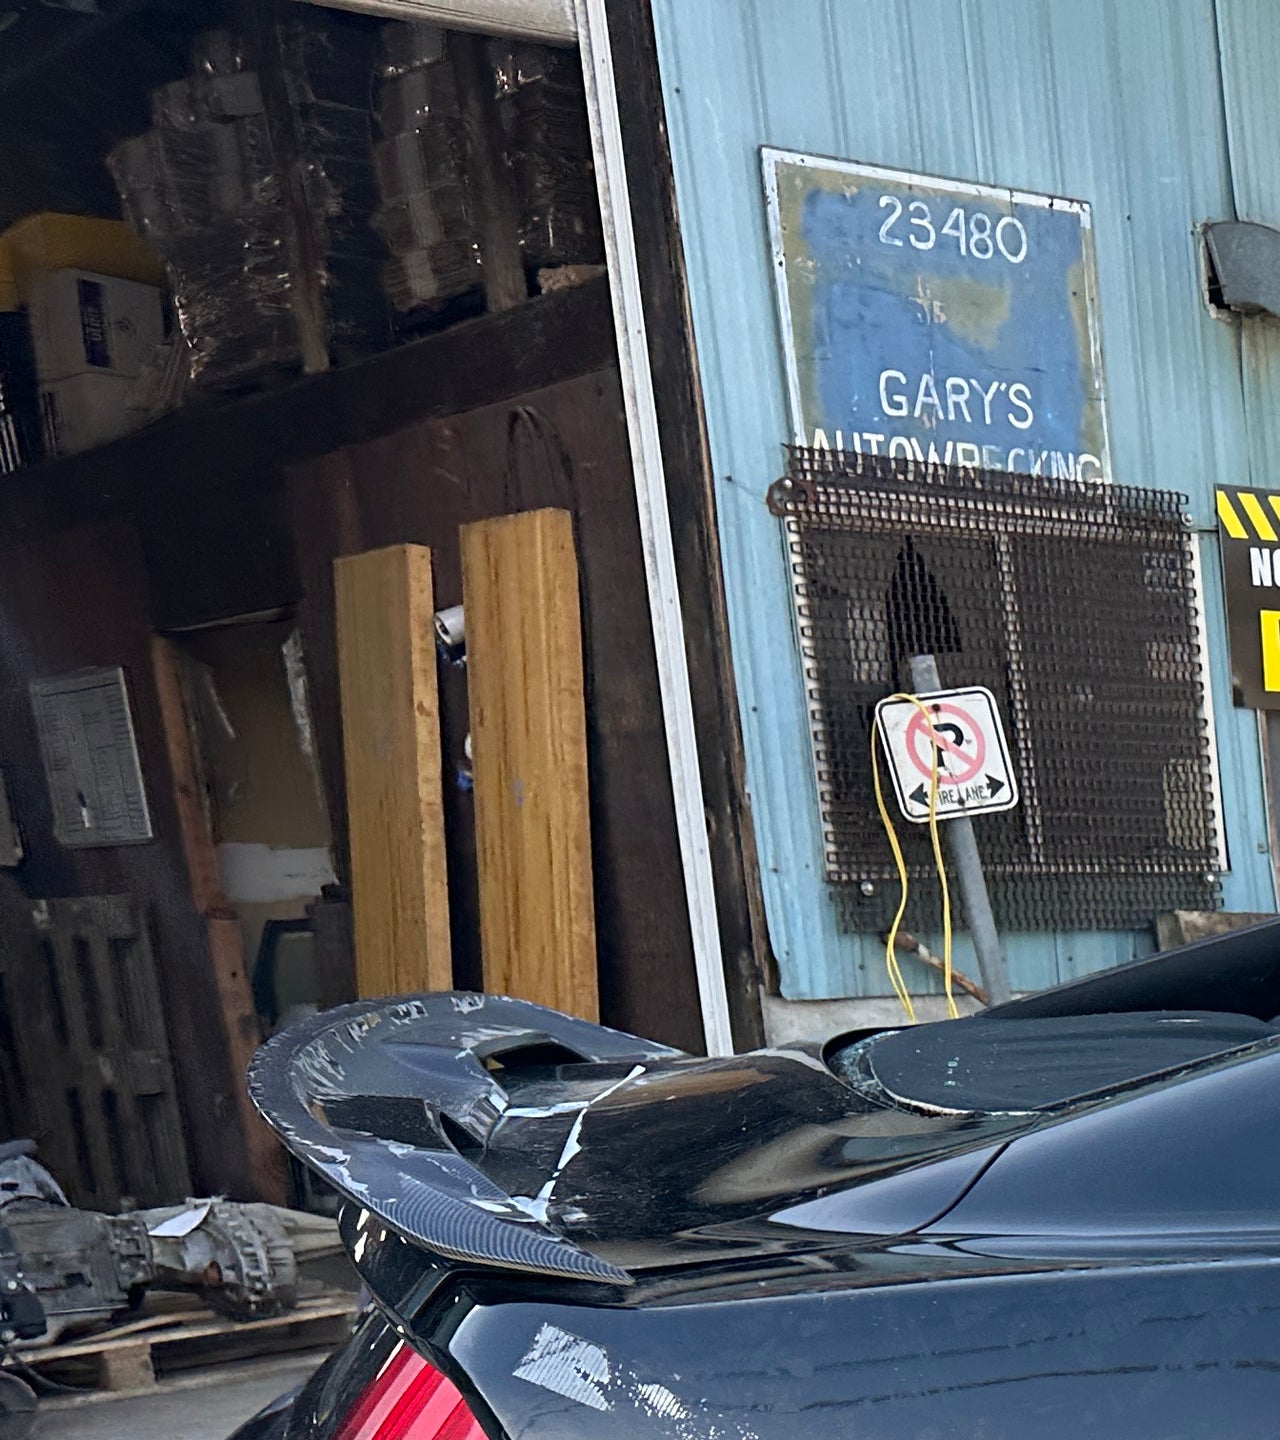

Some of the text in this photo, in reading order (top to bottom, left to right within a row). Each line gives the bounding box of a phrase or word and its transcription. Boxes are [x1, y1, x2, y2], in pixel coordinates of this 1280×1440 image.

[879, 195, 1027, 264] 23480
[879, 369, 1034, 429] GARY'S
[936, 785, 989, 805] IRE ANE
